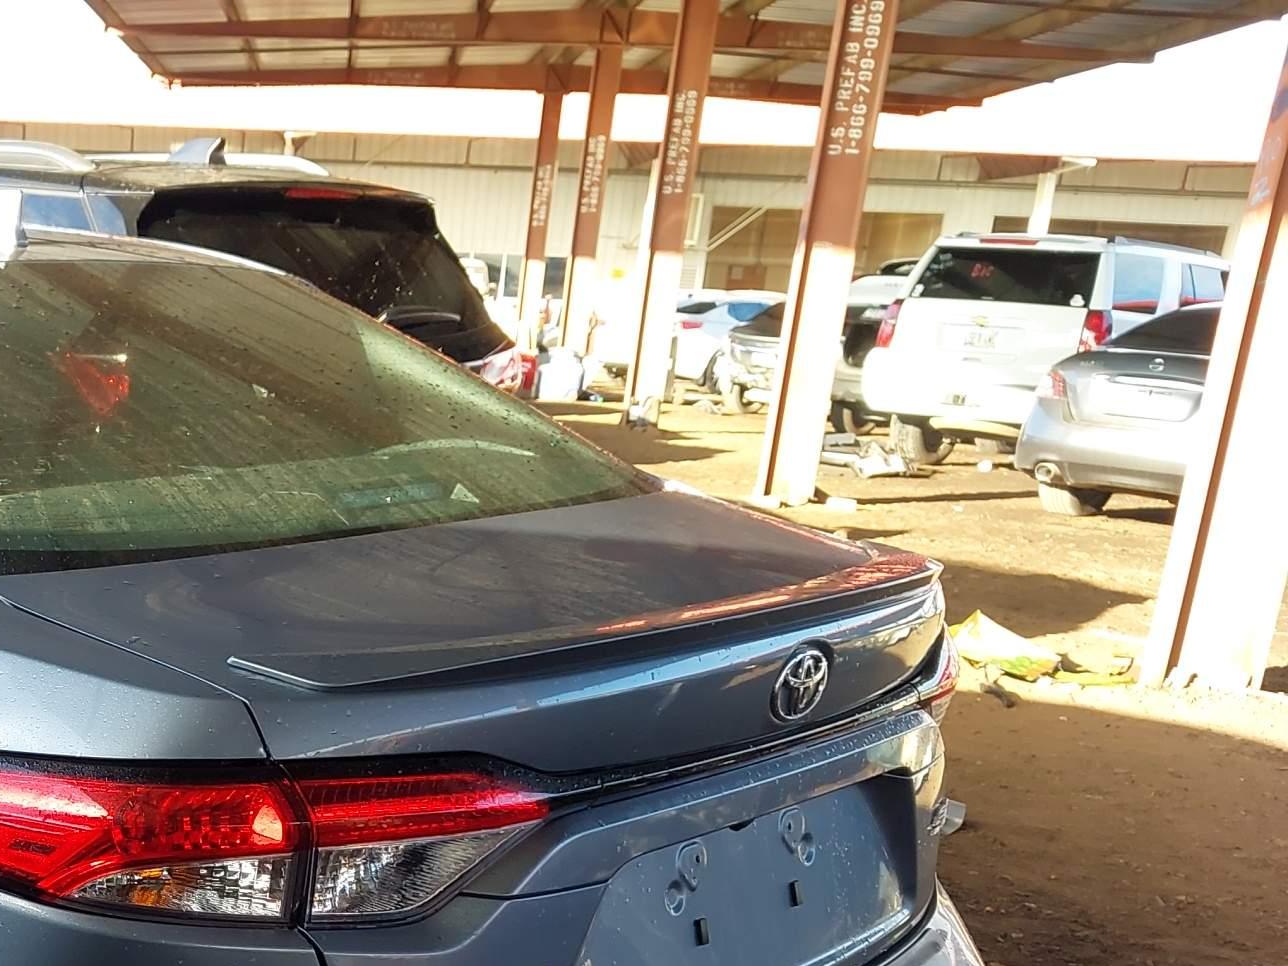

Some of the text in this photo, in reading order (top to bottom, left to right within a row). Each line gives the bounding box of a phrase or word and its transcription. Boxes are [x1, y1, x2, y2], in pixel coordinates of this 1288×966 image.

[835, 42, 860, 112] PREFAB
[844, 0, 885, 155] 1-866-799-0969
[666, 118, 683, 166] PREFAB
[827, 121, 847, 155] U.S.
